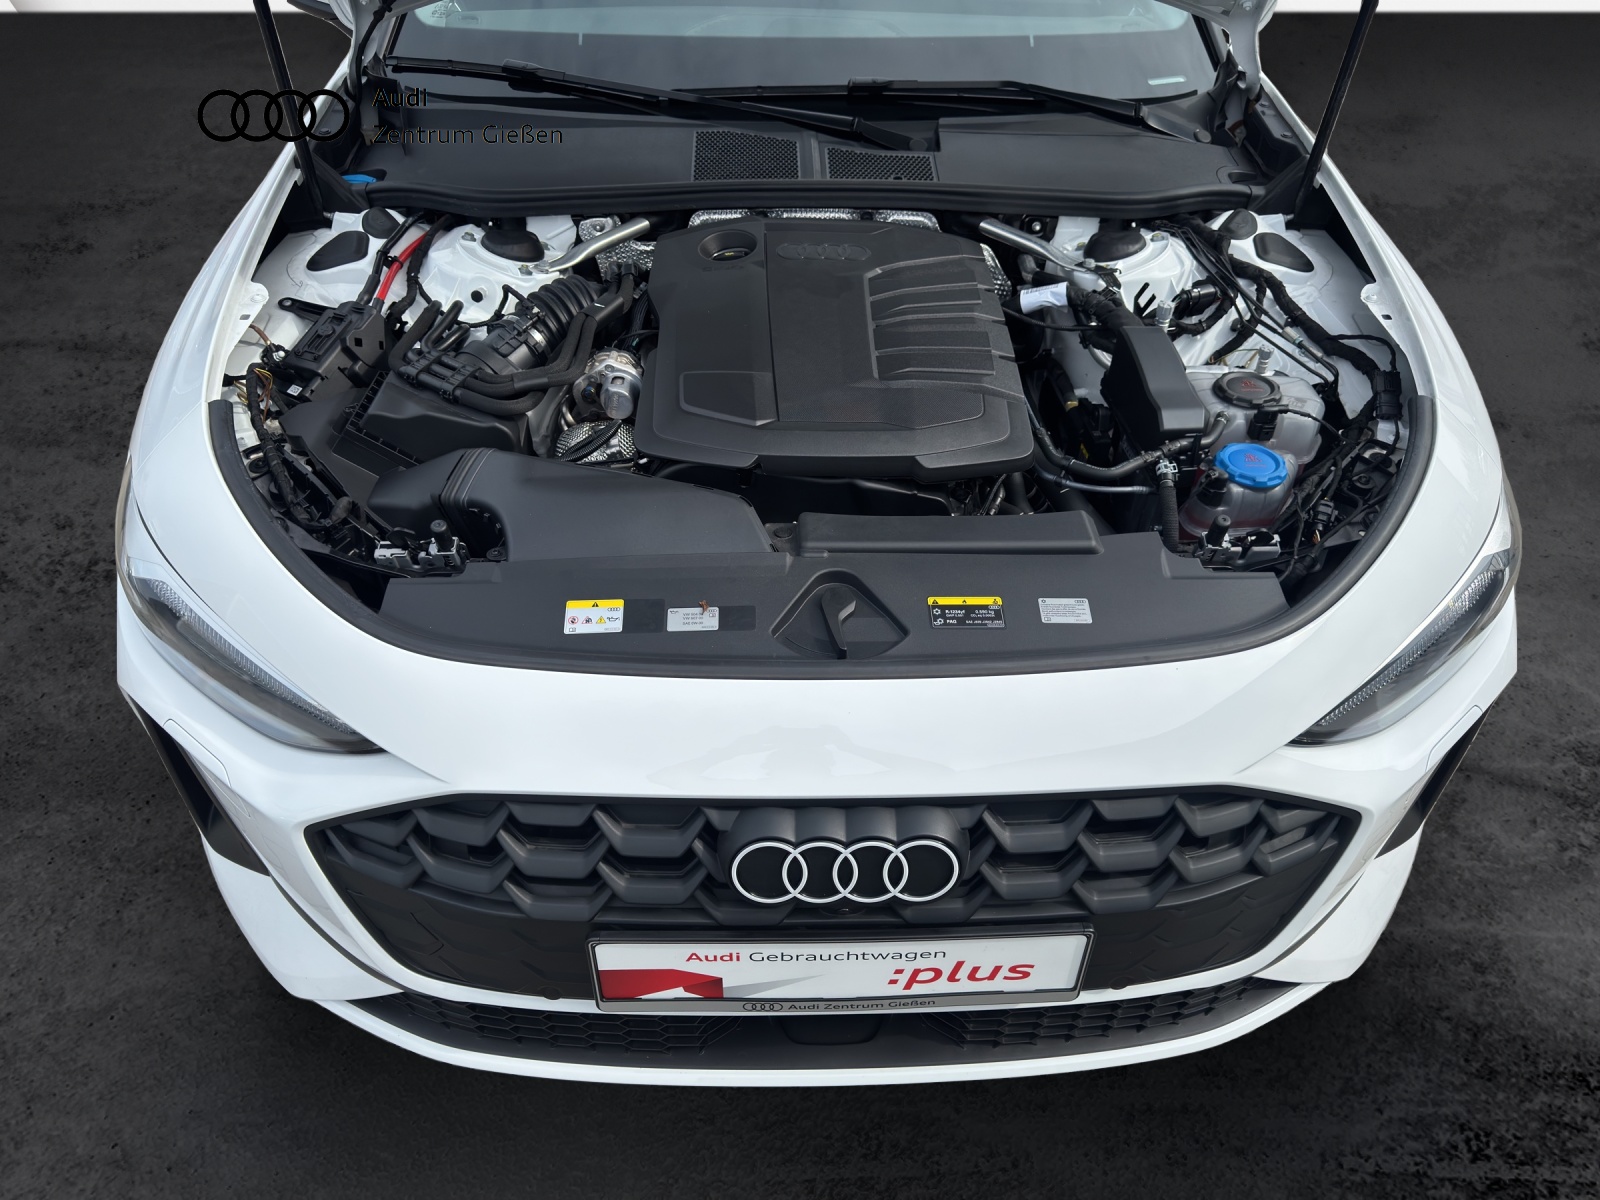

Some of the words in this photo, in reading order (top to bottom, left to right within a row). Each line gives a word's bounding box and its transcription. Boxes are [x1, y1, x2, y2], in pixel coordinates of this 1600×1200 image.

[686, 951, 741, 962] Audi
[749, 950, 946, 962] Gebrauchtwagen
[888, 1000, 936, 1008] Gießen
